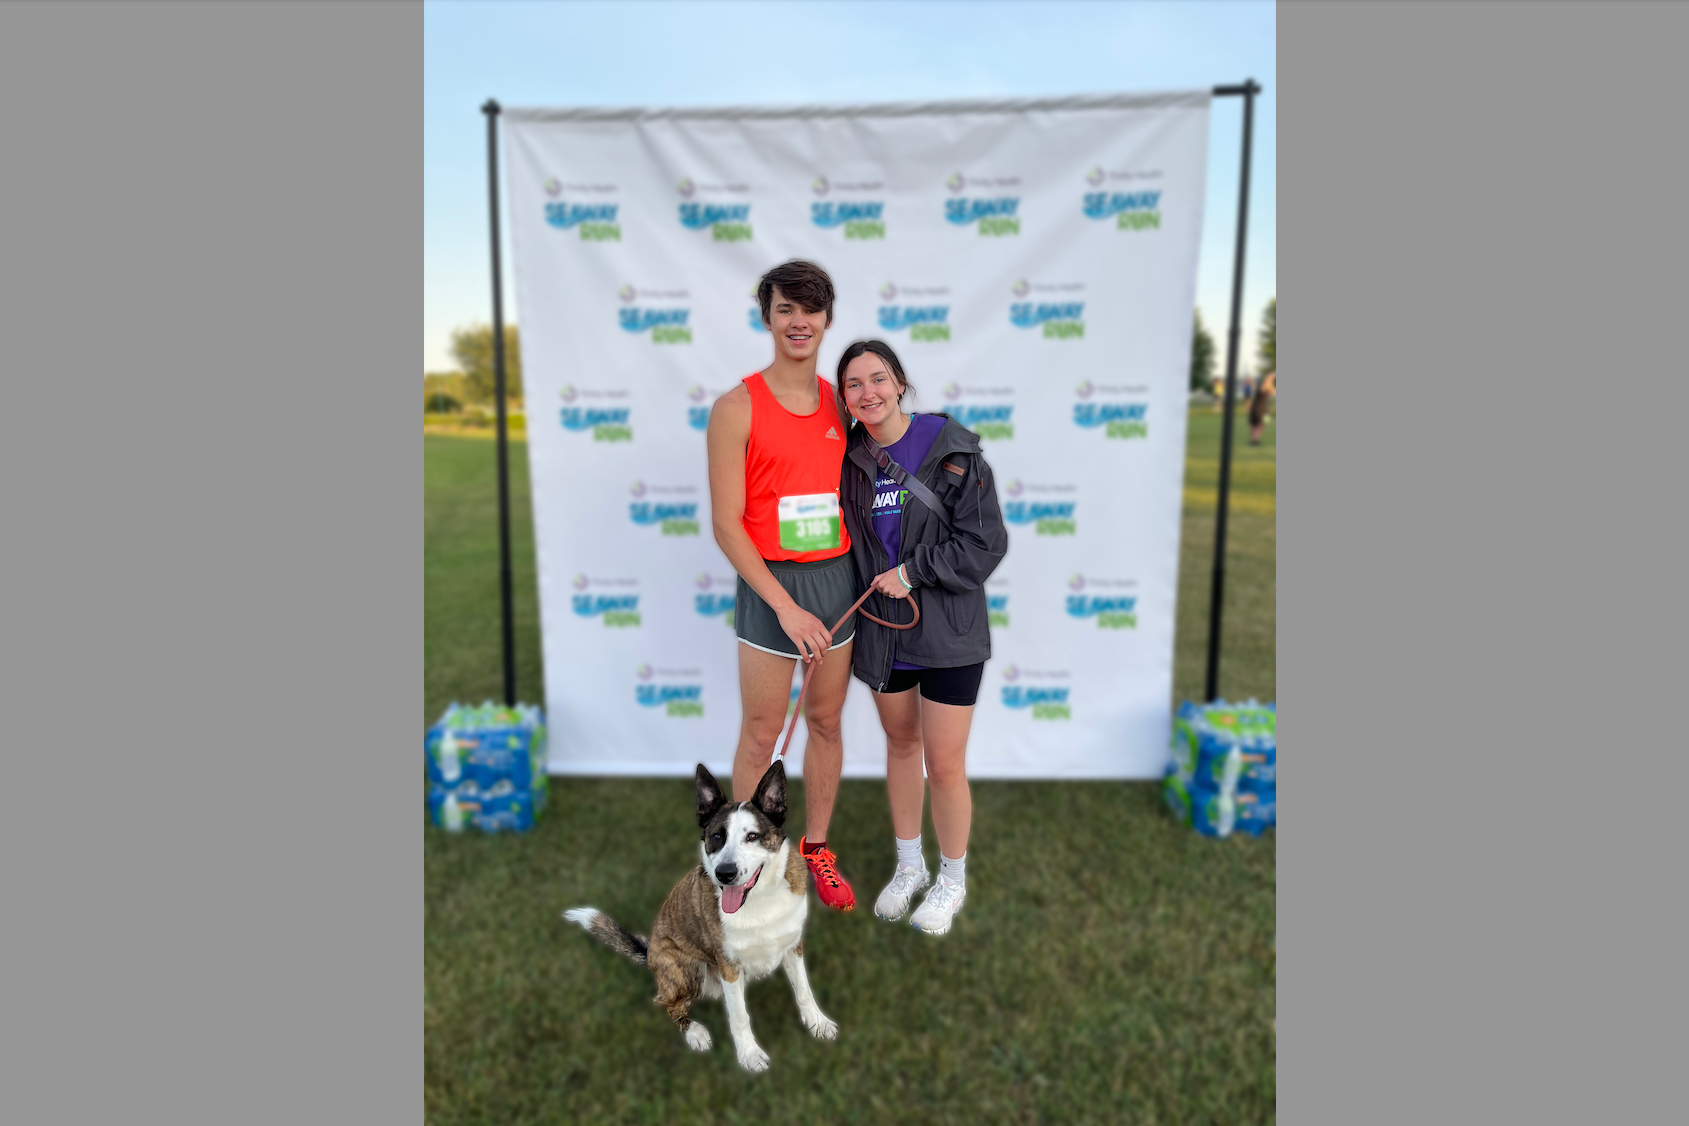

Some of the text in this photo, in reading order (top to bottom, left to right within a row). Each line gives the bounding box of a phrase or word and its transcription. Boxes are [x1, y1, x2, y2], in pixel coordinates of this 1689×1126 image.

[544, 202, 618, 227] SEAWAY
[811, 202, 884, 226] SEAWAY
[944, 197, 1019, 223] SEAWAY
[1082, 190, 1160, 218] SEAWAY
[678, 203, 751, 228] SEAWAY
[1116, 211, 1160, 232] RUN
[579, 223, 621, 242] RUN
[712, 223, 753, 242] RUN
[844, 221, 885, 240] RUN
[978, 217, 1020, 237] RUN
[618, 307, 690, 331] SEAWAY
[877, 305, 949, 329] SEAWAY
[1009, 302, 1084, 326] SEAWAY
[652, 327, 692, 344] RUN
[910, 324, 951, 343] RUN
[1043, 320, 1084, 340] RUN
[560, 406, 630, 429] SEAWAY
[942, 405, 1013, 426] SEAWAY
[1072, 403, 1147, 426] SEAWAY
[593, 426, 632, 443] RUN
[974, 423, 1013, 441] RUN
[1105, 421, 1147, 440] RUN
[871, 490, 900, 509] WAY
[628, 502, 698, 524] SEAWAY
[1003, 501, 1076, 523] SEAWAY
[796, 518, 832, 538] 3105
[571, 594, 640, 616] SEAWAY
[1065, 594, 1137, 617] SEAWAY
